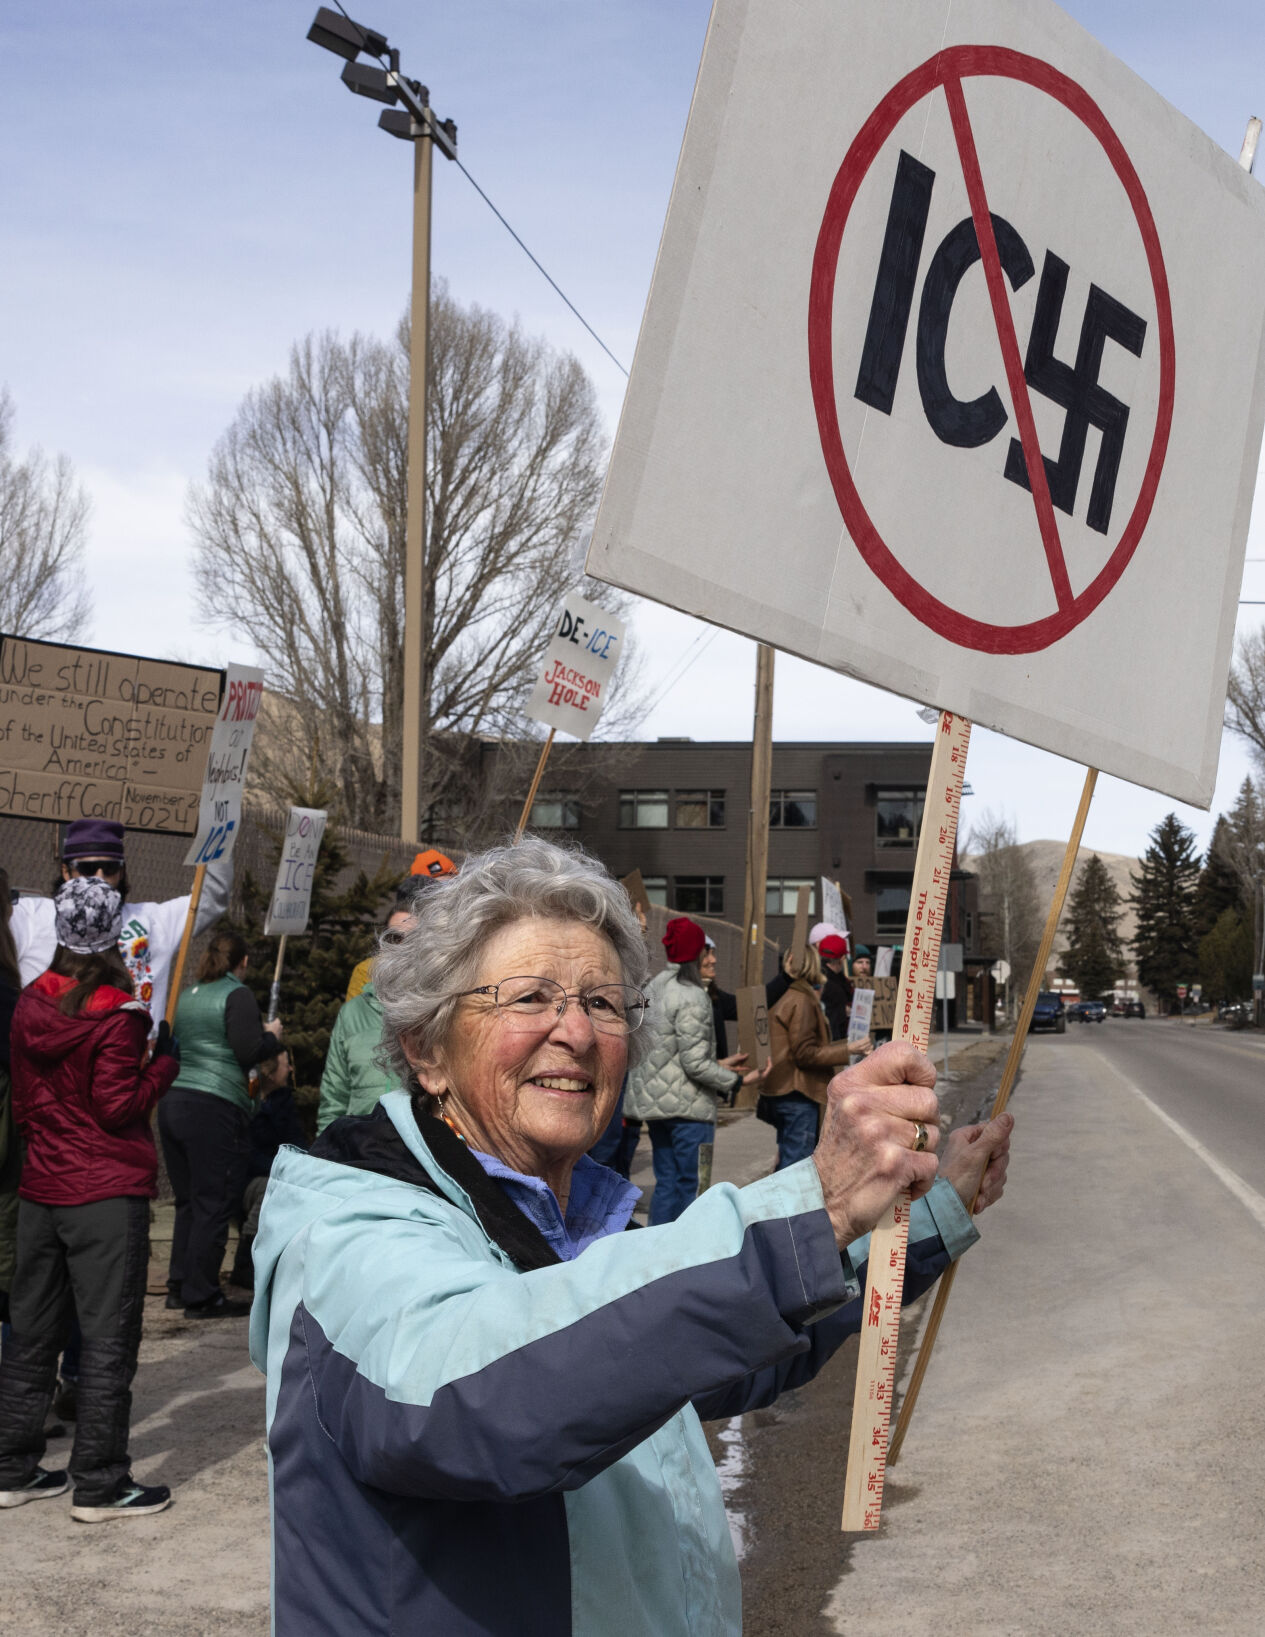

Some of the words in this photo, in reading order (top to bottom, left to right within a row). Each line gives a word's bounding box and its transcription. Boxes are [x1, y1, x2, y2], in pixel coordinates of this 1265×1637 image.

[558, 609, 618, 659] DE-ICE
[2, 640, 43, 687] We
[56, 655, 110, 697] still
[119, 678, 217, 713] operate
[544, 659, 601, 699] JACKSON
[0, 688, 55, 706] under
[62, 694, 83, 710] the
[548, 681, 590, 711] HOLE
[942, 711, 953, 736] CE
[22, 723, 44, 743] the
[51, 724, 107, 754] United
[110, 740, 167, 760] States
[175, 744, 195, 762] of
[951, 746, 960, 763] 18
[125, 787, 184, 807] November
[944, 786, 954, 804] 19
[124, 806, 189, 833] 2024
[214, 800, 229, 822] NOT
[194, 821, 236, 863] ICE
[938, 826, 948, 844] 20
[279, 859, 314, 892] ICE
[932, 867, 942, 884] 21
[916, 890, 928, 921] The
[926, 909, 936, 927] 22
[908, 926, 923, 984] helpful
[921, 950, 930, 968] 23
[916, 991, 925, 1010] 24
[902, 987, 914, 1038] place.
[893, 1205, 903, 1224] 29
[889, 1248, 898, 1267] 30
[868, 1285, 883, 1328] ACE
[885, 1292, 894, 1311] 31
[880, 1336, 890, 1356] 32
[876, 1381, 886, 1401] 33
[872, 1427, 881, 1446] 34
[867, 1472, 877, 1491] 35
[864, 1510, 873, 1527] 36
